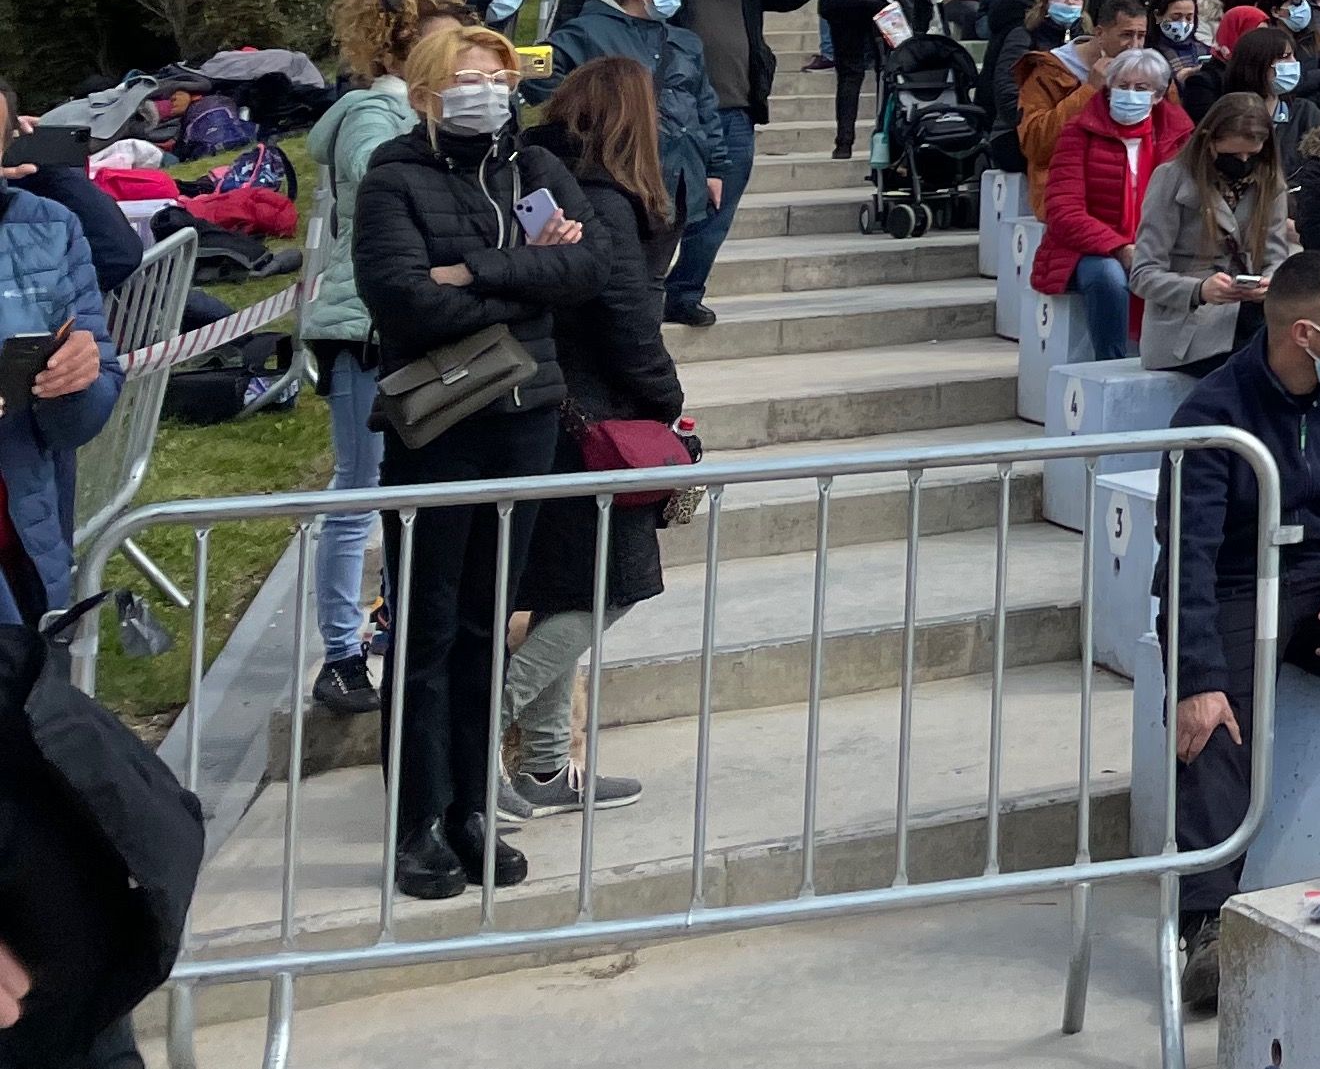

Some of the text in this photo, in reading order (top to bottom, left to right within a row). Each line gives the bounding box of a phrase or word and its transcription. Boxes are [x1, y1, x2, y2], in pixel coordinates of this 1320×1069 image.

[1017, 234, 1023, 253] 6
[1042, 303, 1048, 326] 5
[1070, 390, 1078, 417] 4
[1115, 507, 1123, 539] 3
